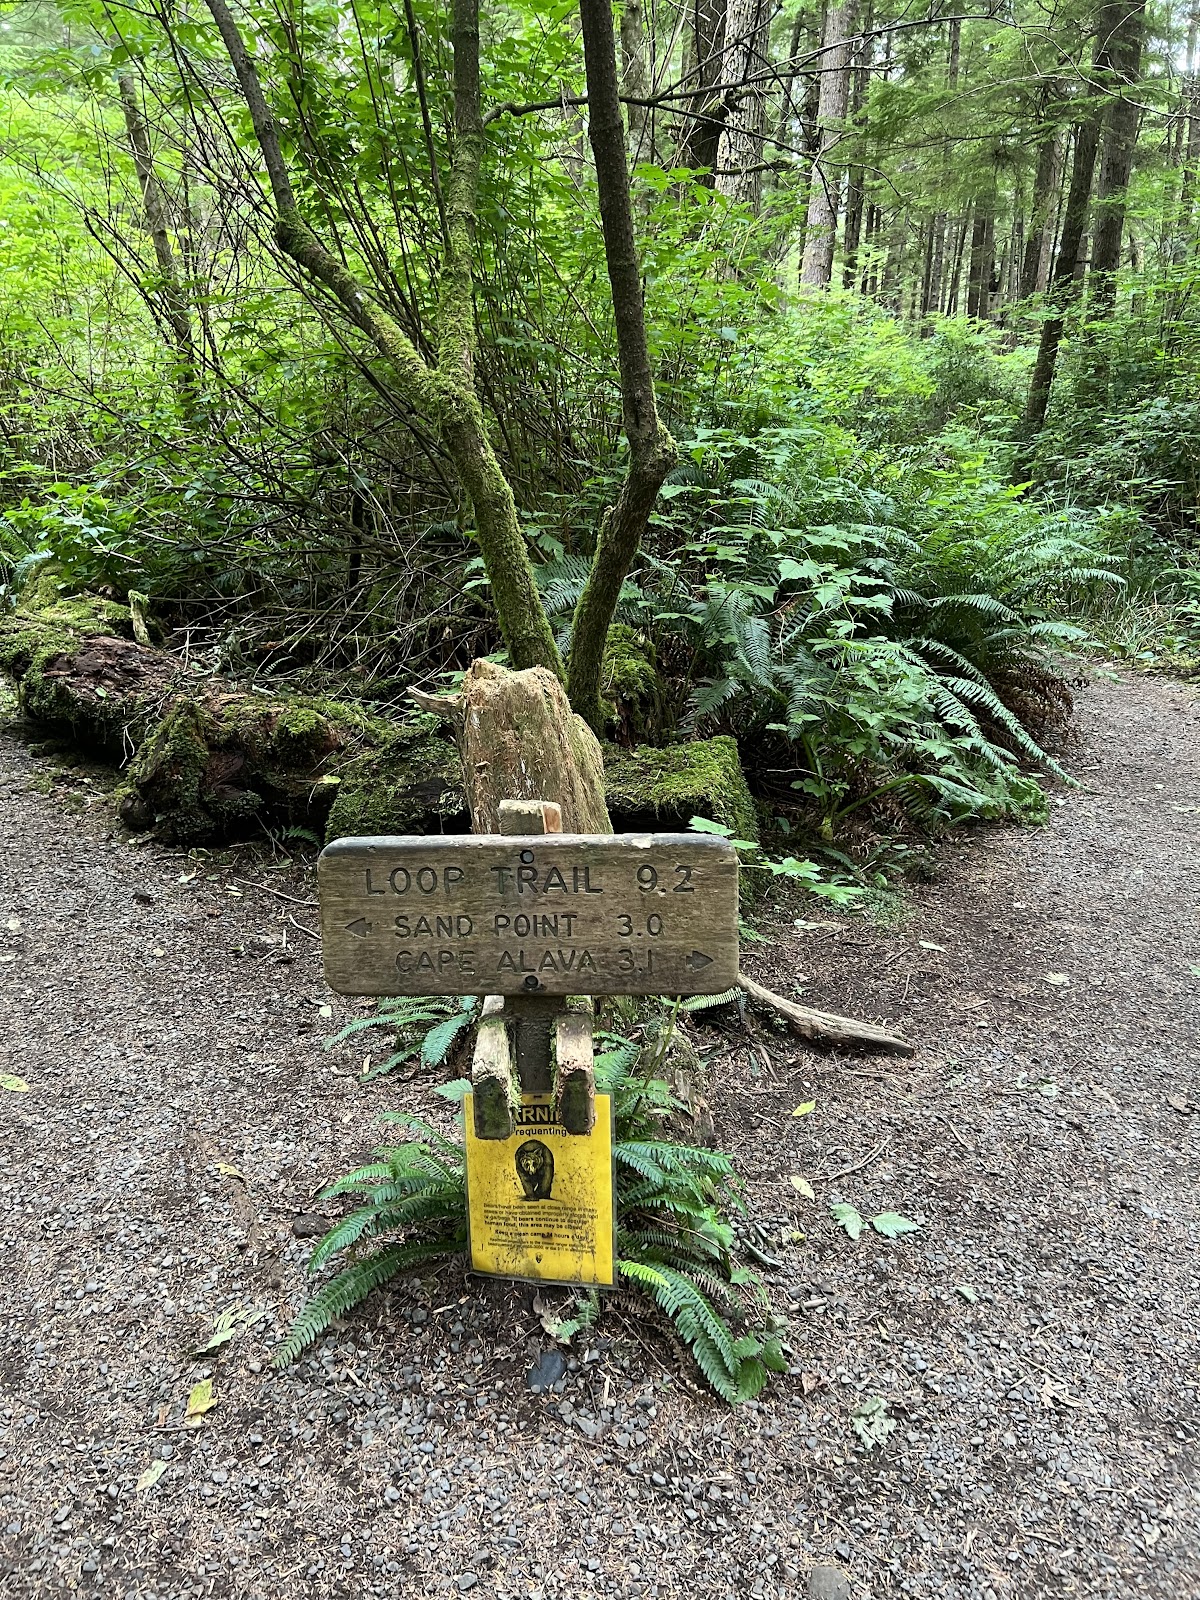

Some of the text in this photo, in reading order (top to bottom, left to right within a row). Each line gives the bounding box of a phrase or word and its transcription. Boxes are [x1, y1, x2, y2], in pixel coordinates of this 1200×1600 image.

[366, 865, 695, 896] LOOP TRAIL 9.2
[394, 914, 664, 938] SAND POINT 3.0
[395, 950, 654, 975] CAPE ALAVA 3.1
[513, 1127, 568, 1137] requenting
